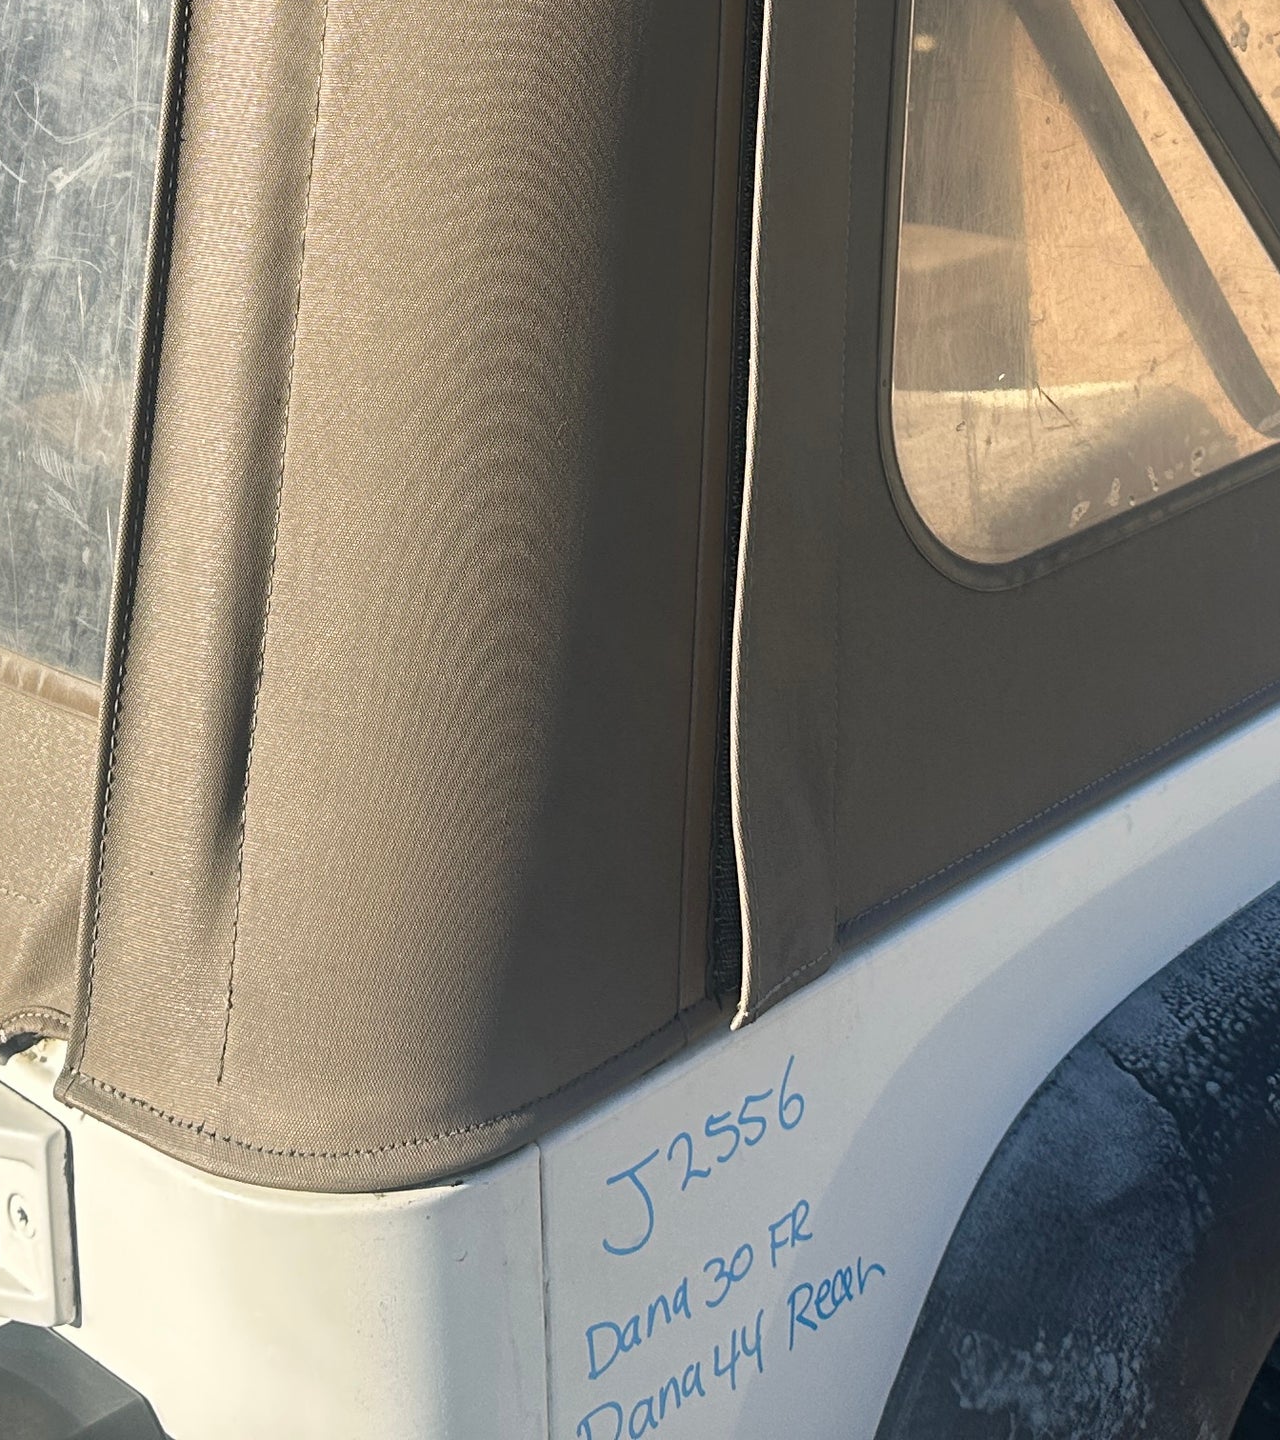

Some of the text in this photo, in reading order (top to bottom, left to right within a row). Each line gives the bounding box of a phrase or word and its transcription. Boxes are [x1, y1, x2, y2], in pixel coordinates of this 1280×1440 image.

[576, 1361, 706, 1440] Dana
[713, 1308, 764, 1391] 44
[585, 1276, 692, 1381] Dana
[703, 1243, 754, 1309] 30
